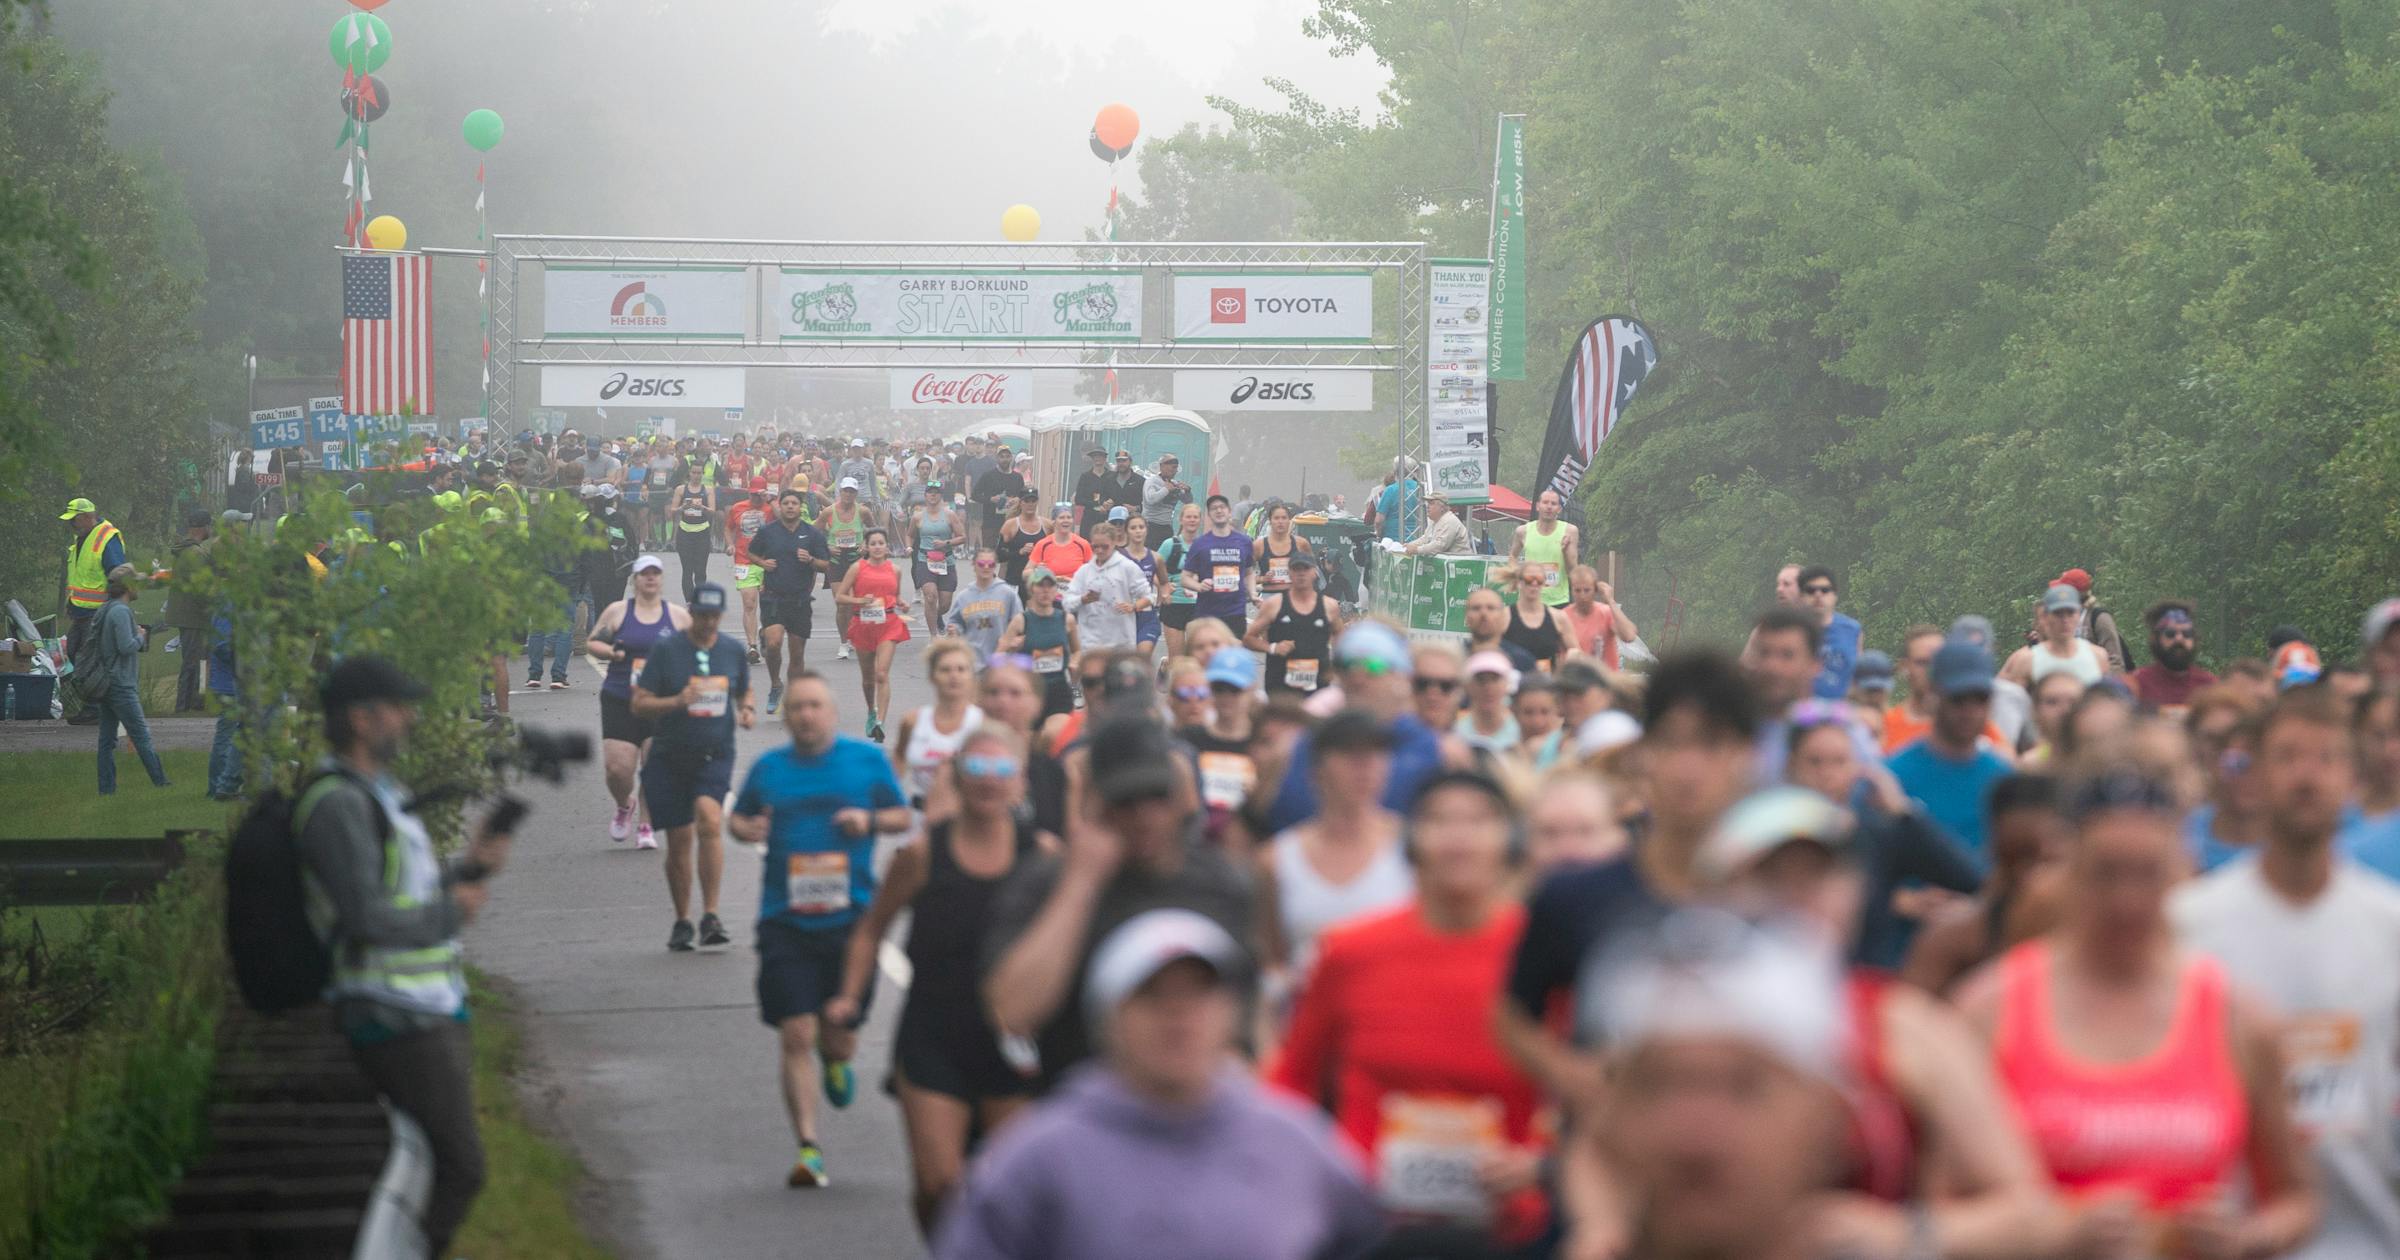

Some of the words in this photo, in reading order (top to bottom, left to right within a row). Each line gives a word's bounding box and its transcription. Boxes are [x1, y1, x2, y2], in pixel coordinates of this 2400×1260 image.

[1514, 127, 1522, 167] RISK
[1514, 172, 1524, 217] LOW
[1497, 219, 1510, 304] CONDITION
[899, 279, 945, 291] GARRY
[951, 279, 1029, 291] BJORKLUND
[1434, 272, 1466, 281] THANK
[1468, 272, 1487, 282] YOU
[896, 294, 1029, 334] START
[1254, 298, 1338, 314] TOYOTA
[610, 317, 667, 326] MEMBERS
[802, 319, 872, 332] Marathon
[1065, 319, 1132, 332] Marathon
[1491, 307, 1504, 373] WEATHER
[627, 379, 684, 397] asics
[911, 372, 1009, 405] Coca-Cola
[1257, 382, 1314, 400] asics
[315, 401, 338, 409] GOAL
[255, 412, 277, 422] GOAL
[278, 410, 298, 419] TIME
[316, 413, 348, 433] 1:4
[257, 422, 300, 444] 1:45
[256, 475, 279, 484] 5199
